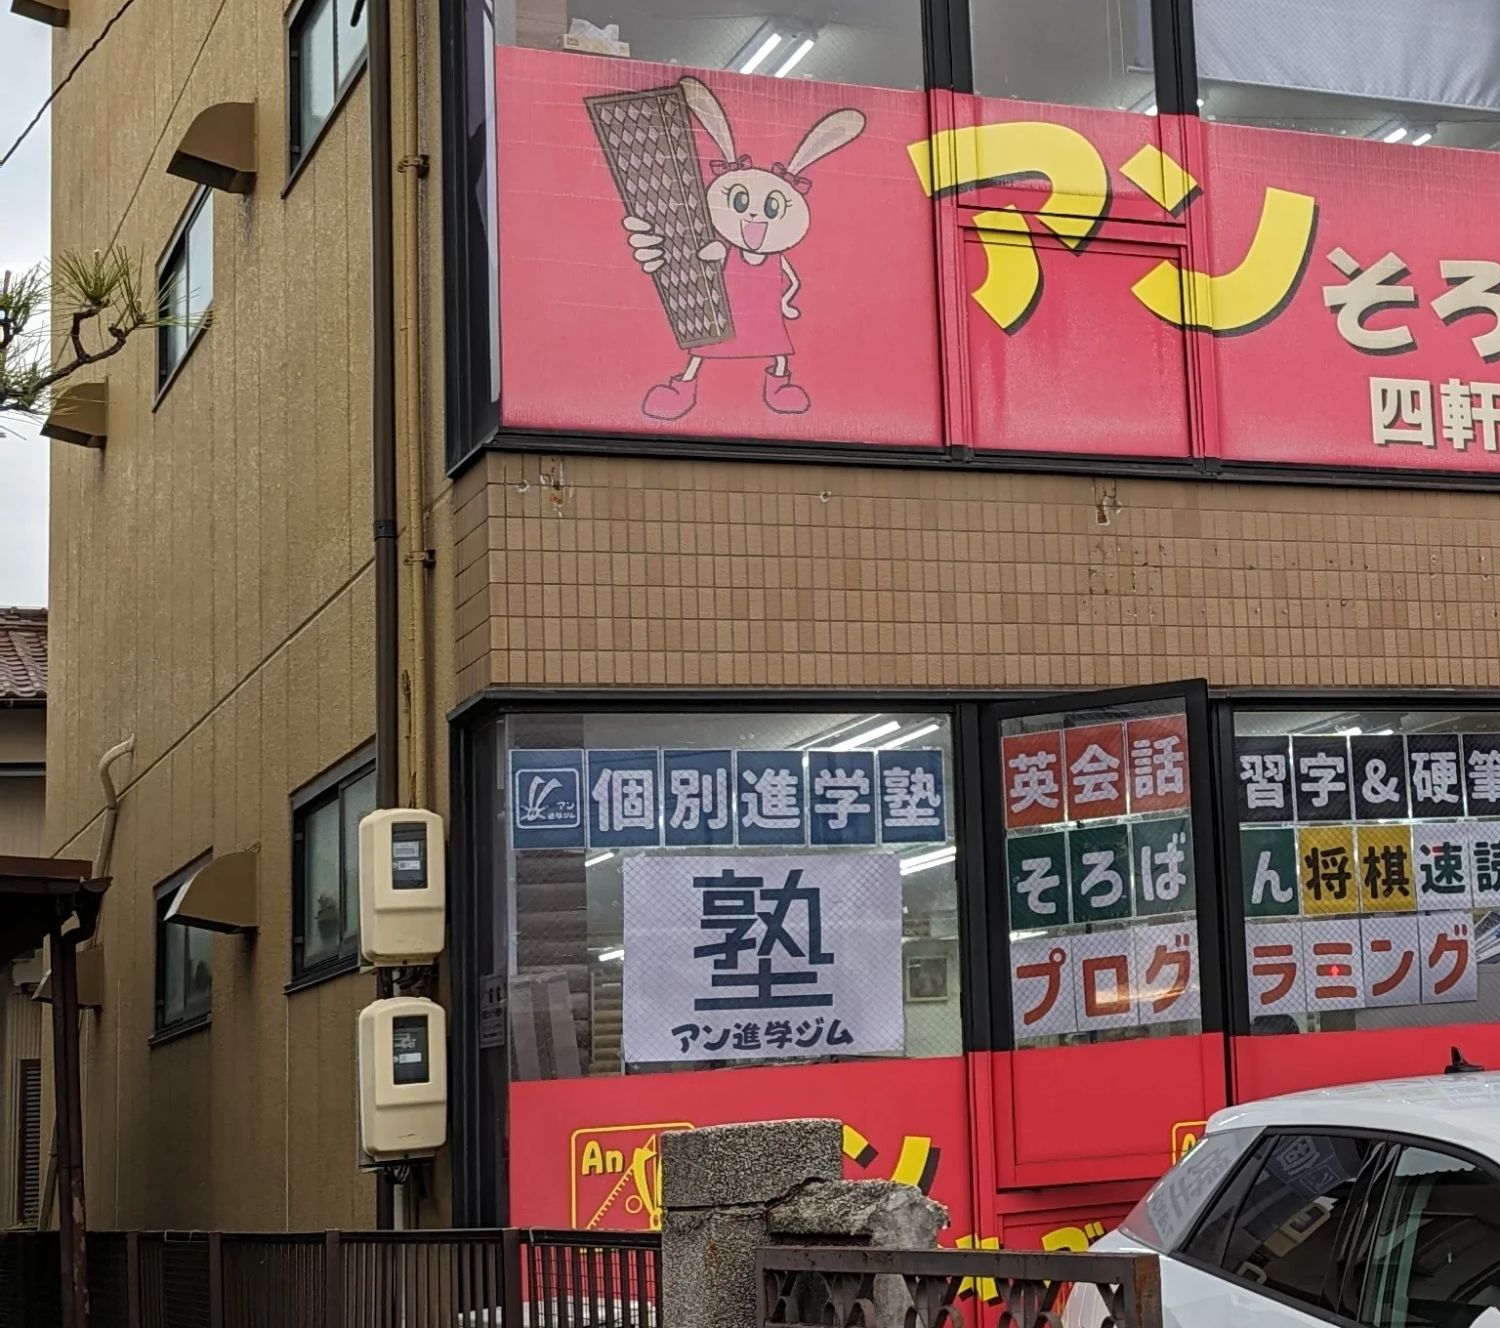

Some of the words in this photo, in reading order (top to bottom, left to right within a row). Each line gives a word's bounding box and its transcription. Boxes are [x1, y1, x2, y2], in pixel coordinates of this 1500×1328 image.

[592, 766, 942, 832] 個別進学塾
[1008, 734, 1185, 814] 英会話
[692, 868, 835, 1012] 塾
[671, 1017, 854, 1054] アン進学ジム
[581, 1140, 624, 1176] An
